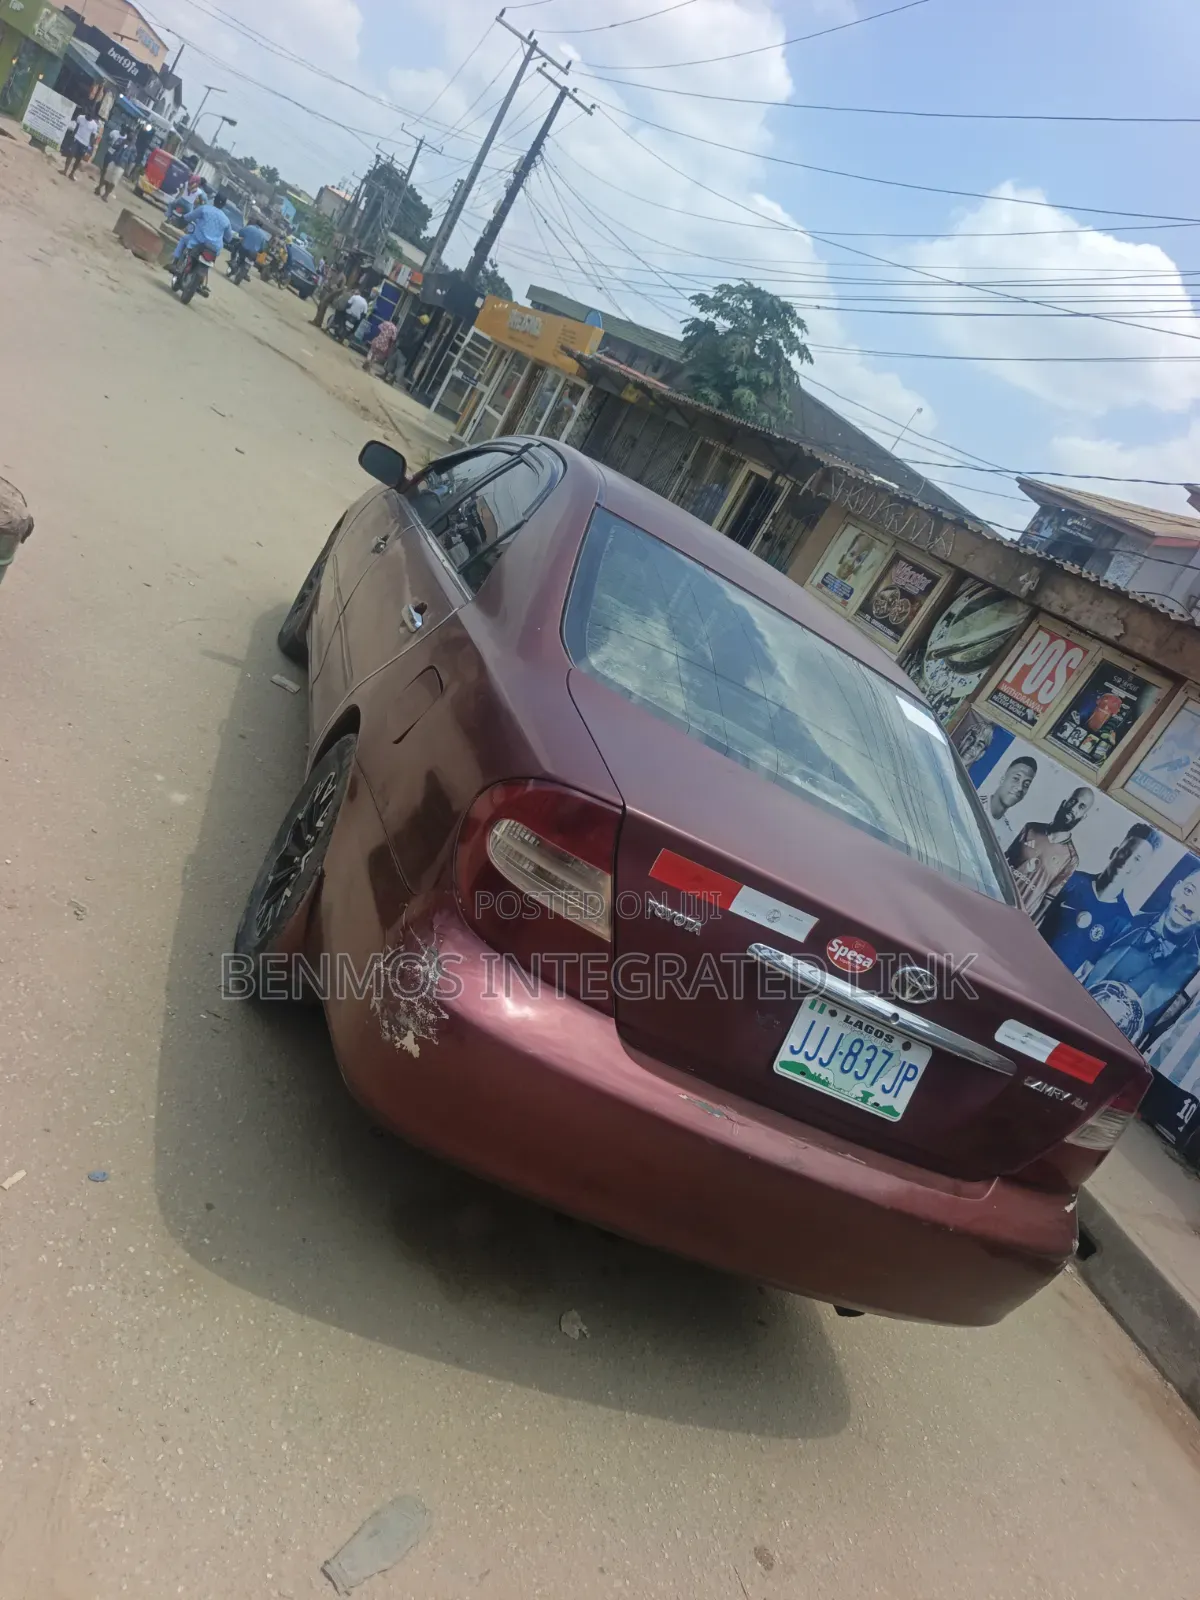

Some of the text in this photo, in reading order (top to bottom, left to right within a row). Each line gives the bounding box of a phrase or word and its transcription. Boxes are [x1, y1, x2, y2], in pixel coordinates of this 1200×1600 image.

[107, 47, 140, 77] bet9ja
[1004, 629, 1084, 705] POS
[1001, 683, 1043, 714] WITHDRAWAL
[1007, 703, 1026, 718] MONEY
[1008, 698, 1026, 712] MONEY
[648, 898, 702, 936] TOYOTA
[828, 938, 874, 968] Spesa
[842, 1014, 895, 1044] LAGOS
[1023, 1075, 1072, 1102] CAMRY
[1176, 1098, 1198, 1125] 10
